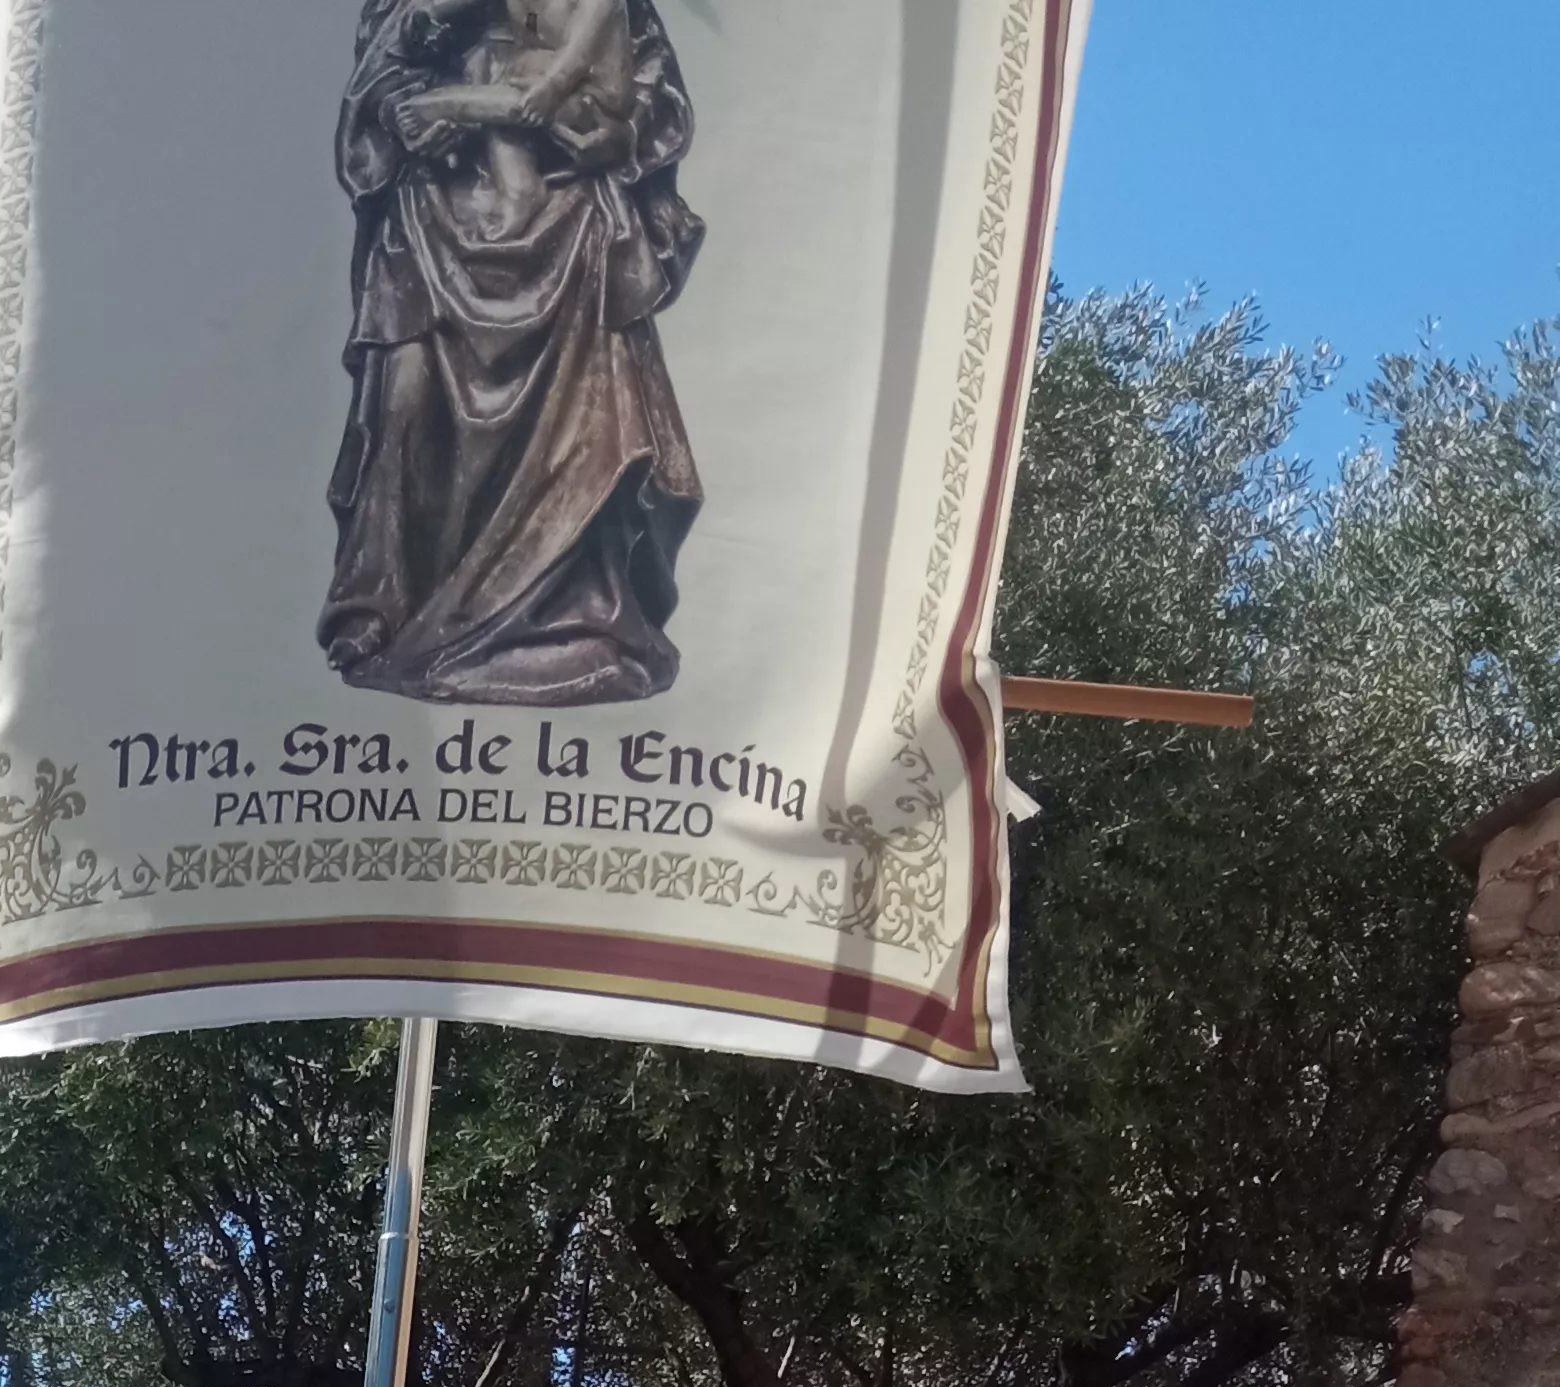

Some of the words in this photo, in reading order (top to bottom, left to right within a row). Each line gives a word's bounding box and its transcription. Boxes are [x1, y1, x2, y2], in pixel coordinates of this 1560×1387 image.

[108, 732, 256, 789] Ntra.
[278, 722, 410, 776] Sra.
[435, 718, 513, 775] de
[536, 720, 590, 778] la
[213, 788, 421, 828] PATRONA
[437, 787, 527, 824] DEL
[542, 790, 714, 838] BIERZO
